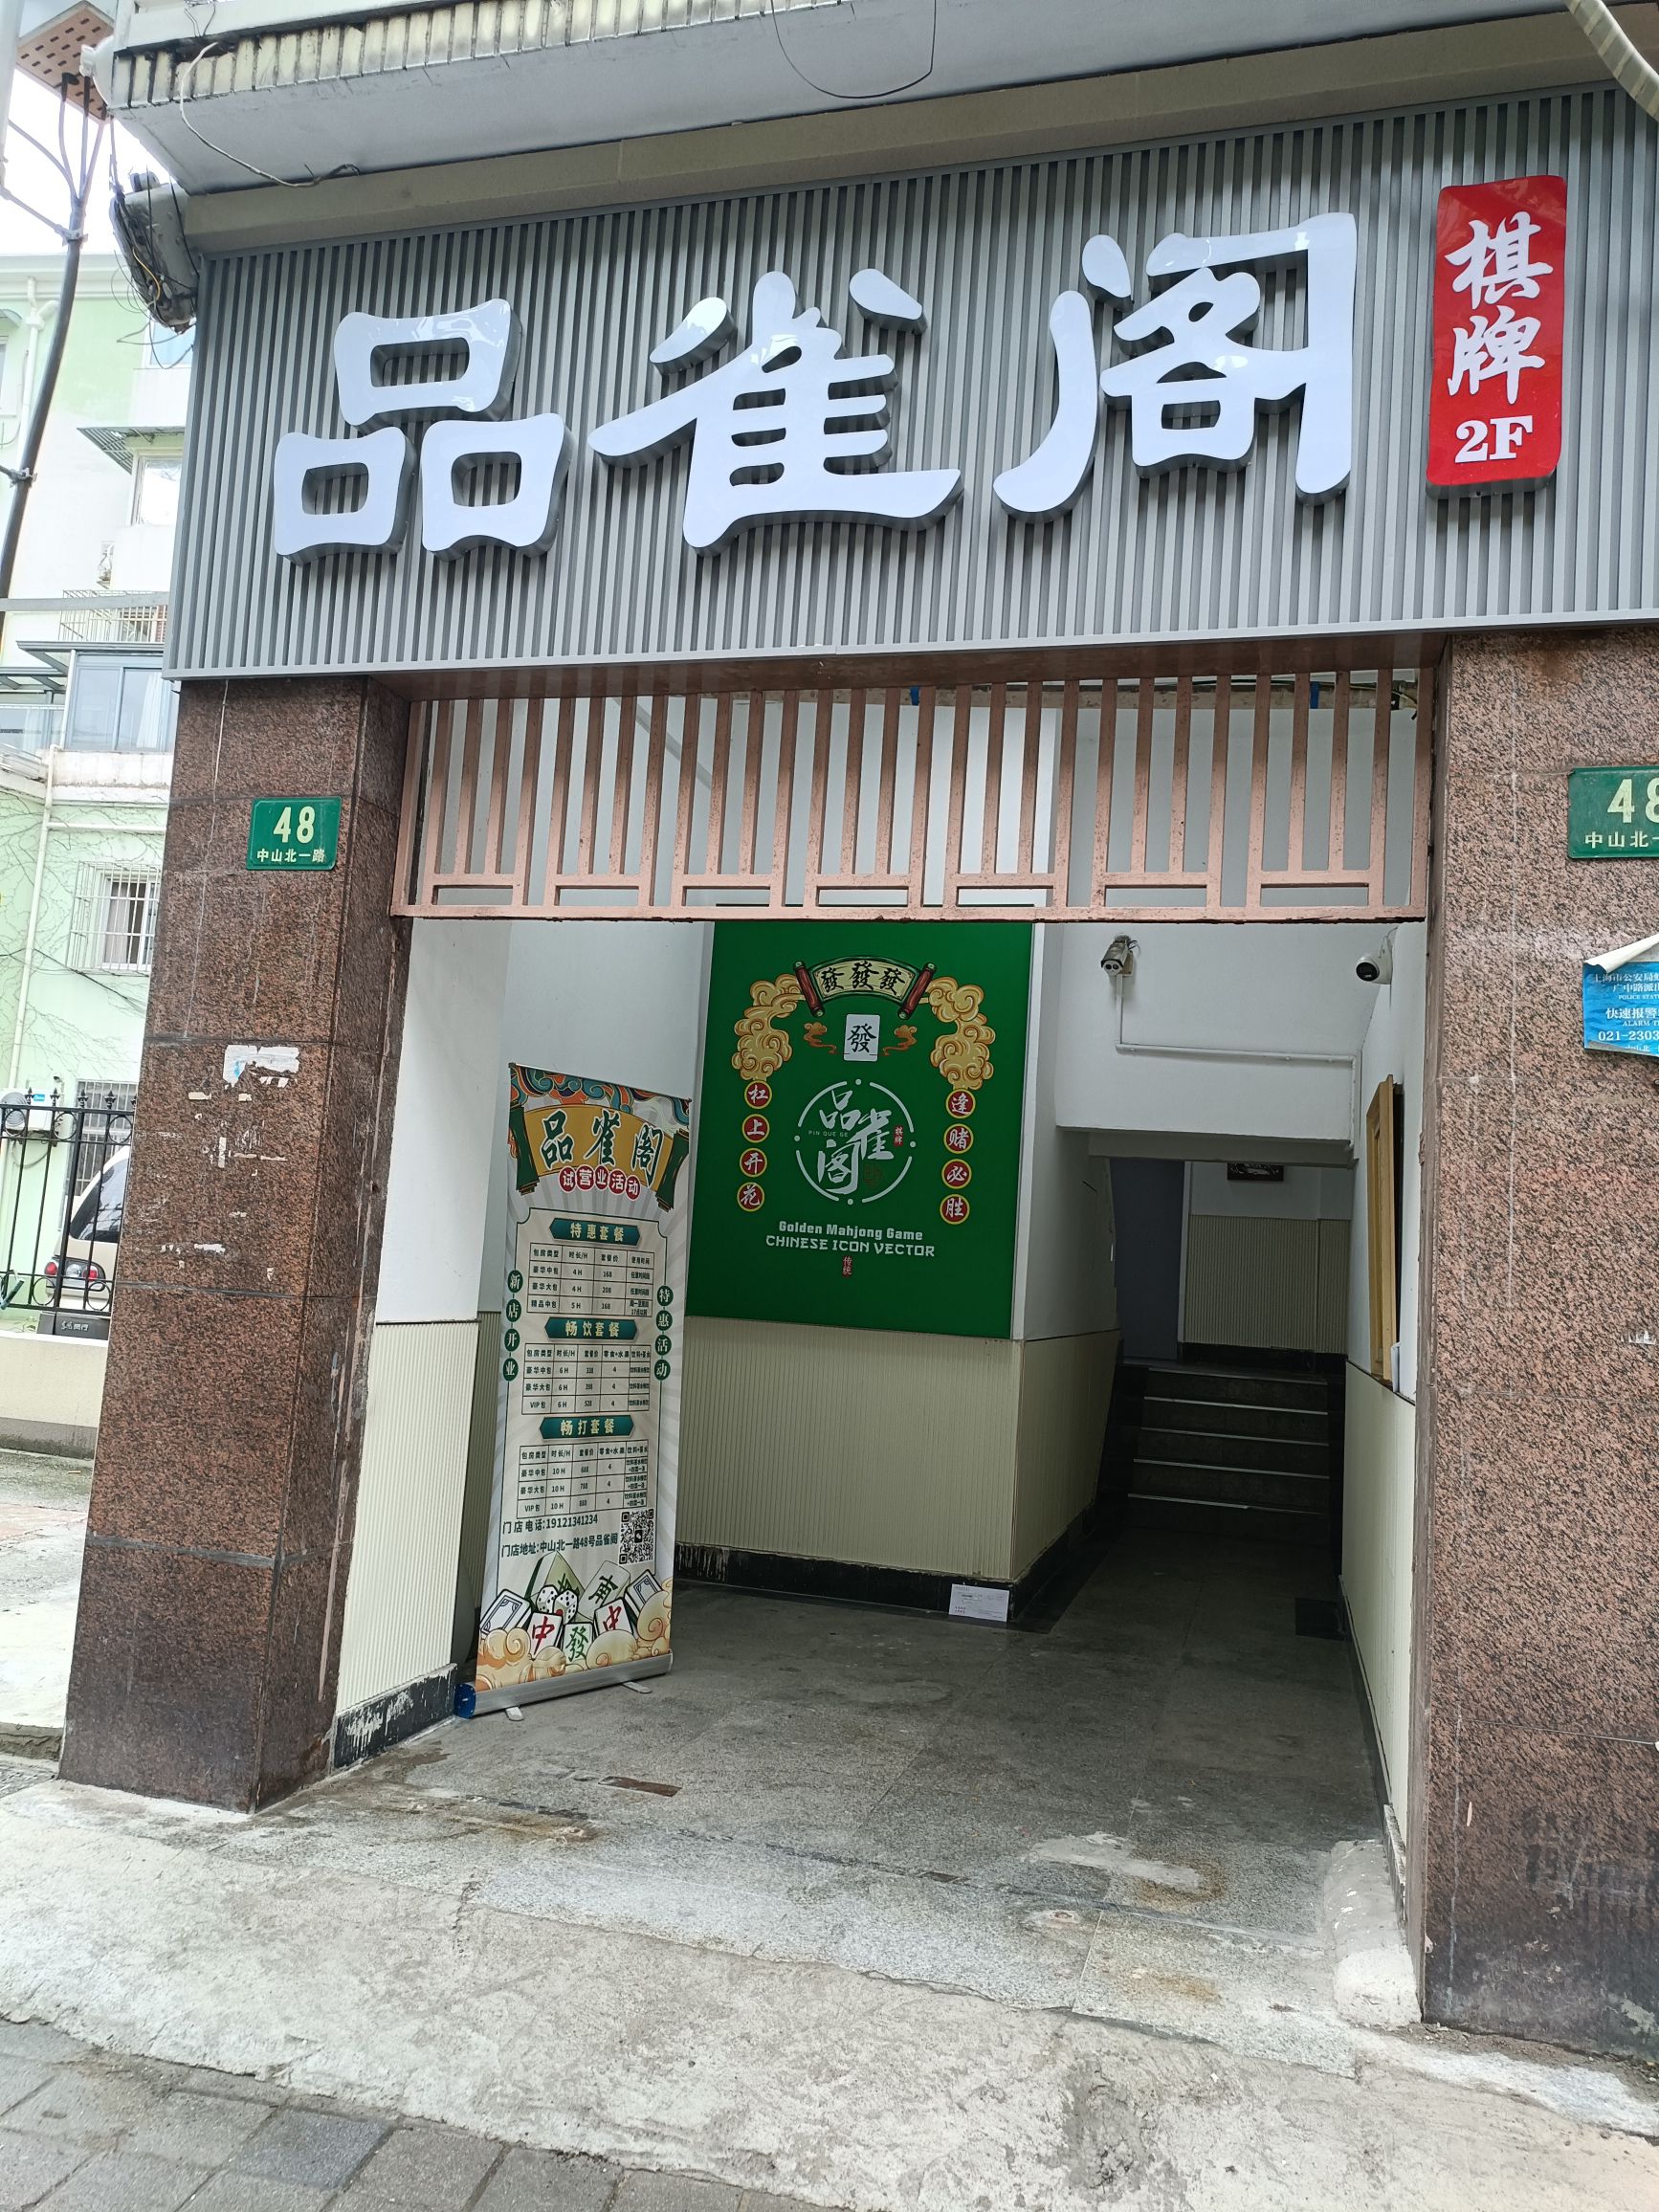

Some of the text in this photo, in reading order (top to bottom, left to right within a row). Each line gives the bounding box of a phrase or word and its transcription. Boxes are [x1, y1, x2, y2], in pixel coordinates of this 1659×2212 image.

[1445, 210, 1553, 405] 棋牌
[274, 212, 1359, 559] 品雀阁
[1455, 415, 1533, 463] 2F
[274, 806, 315, 843] 48
[256, 848, 325, 863] 中山北一路
[1605, 1007, 1659, 1020] 快速报警
[847, 1023, 876, 1053] 發
[1598, 1029, 1659, 1042] 021-2303
[541, 1108, 664, 1186] 品雀阁
[741, 1084, 768, 1206] 杠上开花
[945, 1093, 971, 1218] 逢赌必胜
[563, 1168, 638, 1196] 试营业活动
[570, 1222, 624, 1242] 特惠套餐
[765, 1235, 935, 1257] CHINESE ICON VECTOR
[779, 1221, 923, 1241] Golden Mahjong Game
[505, 1273, 520, 1376] 新店开业
[564, 1320, 620, 1338] 畅饮套餐
[656, 1289, 671, 1377] 特惠活动
[560, 1419, 614, 1436] 畅打套餐
[531, 1615, 555, 1656] 中
